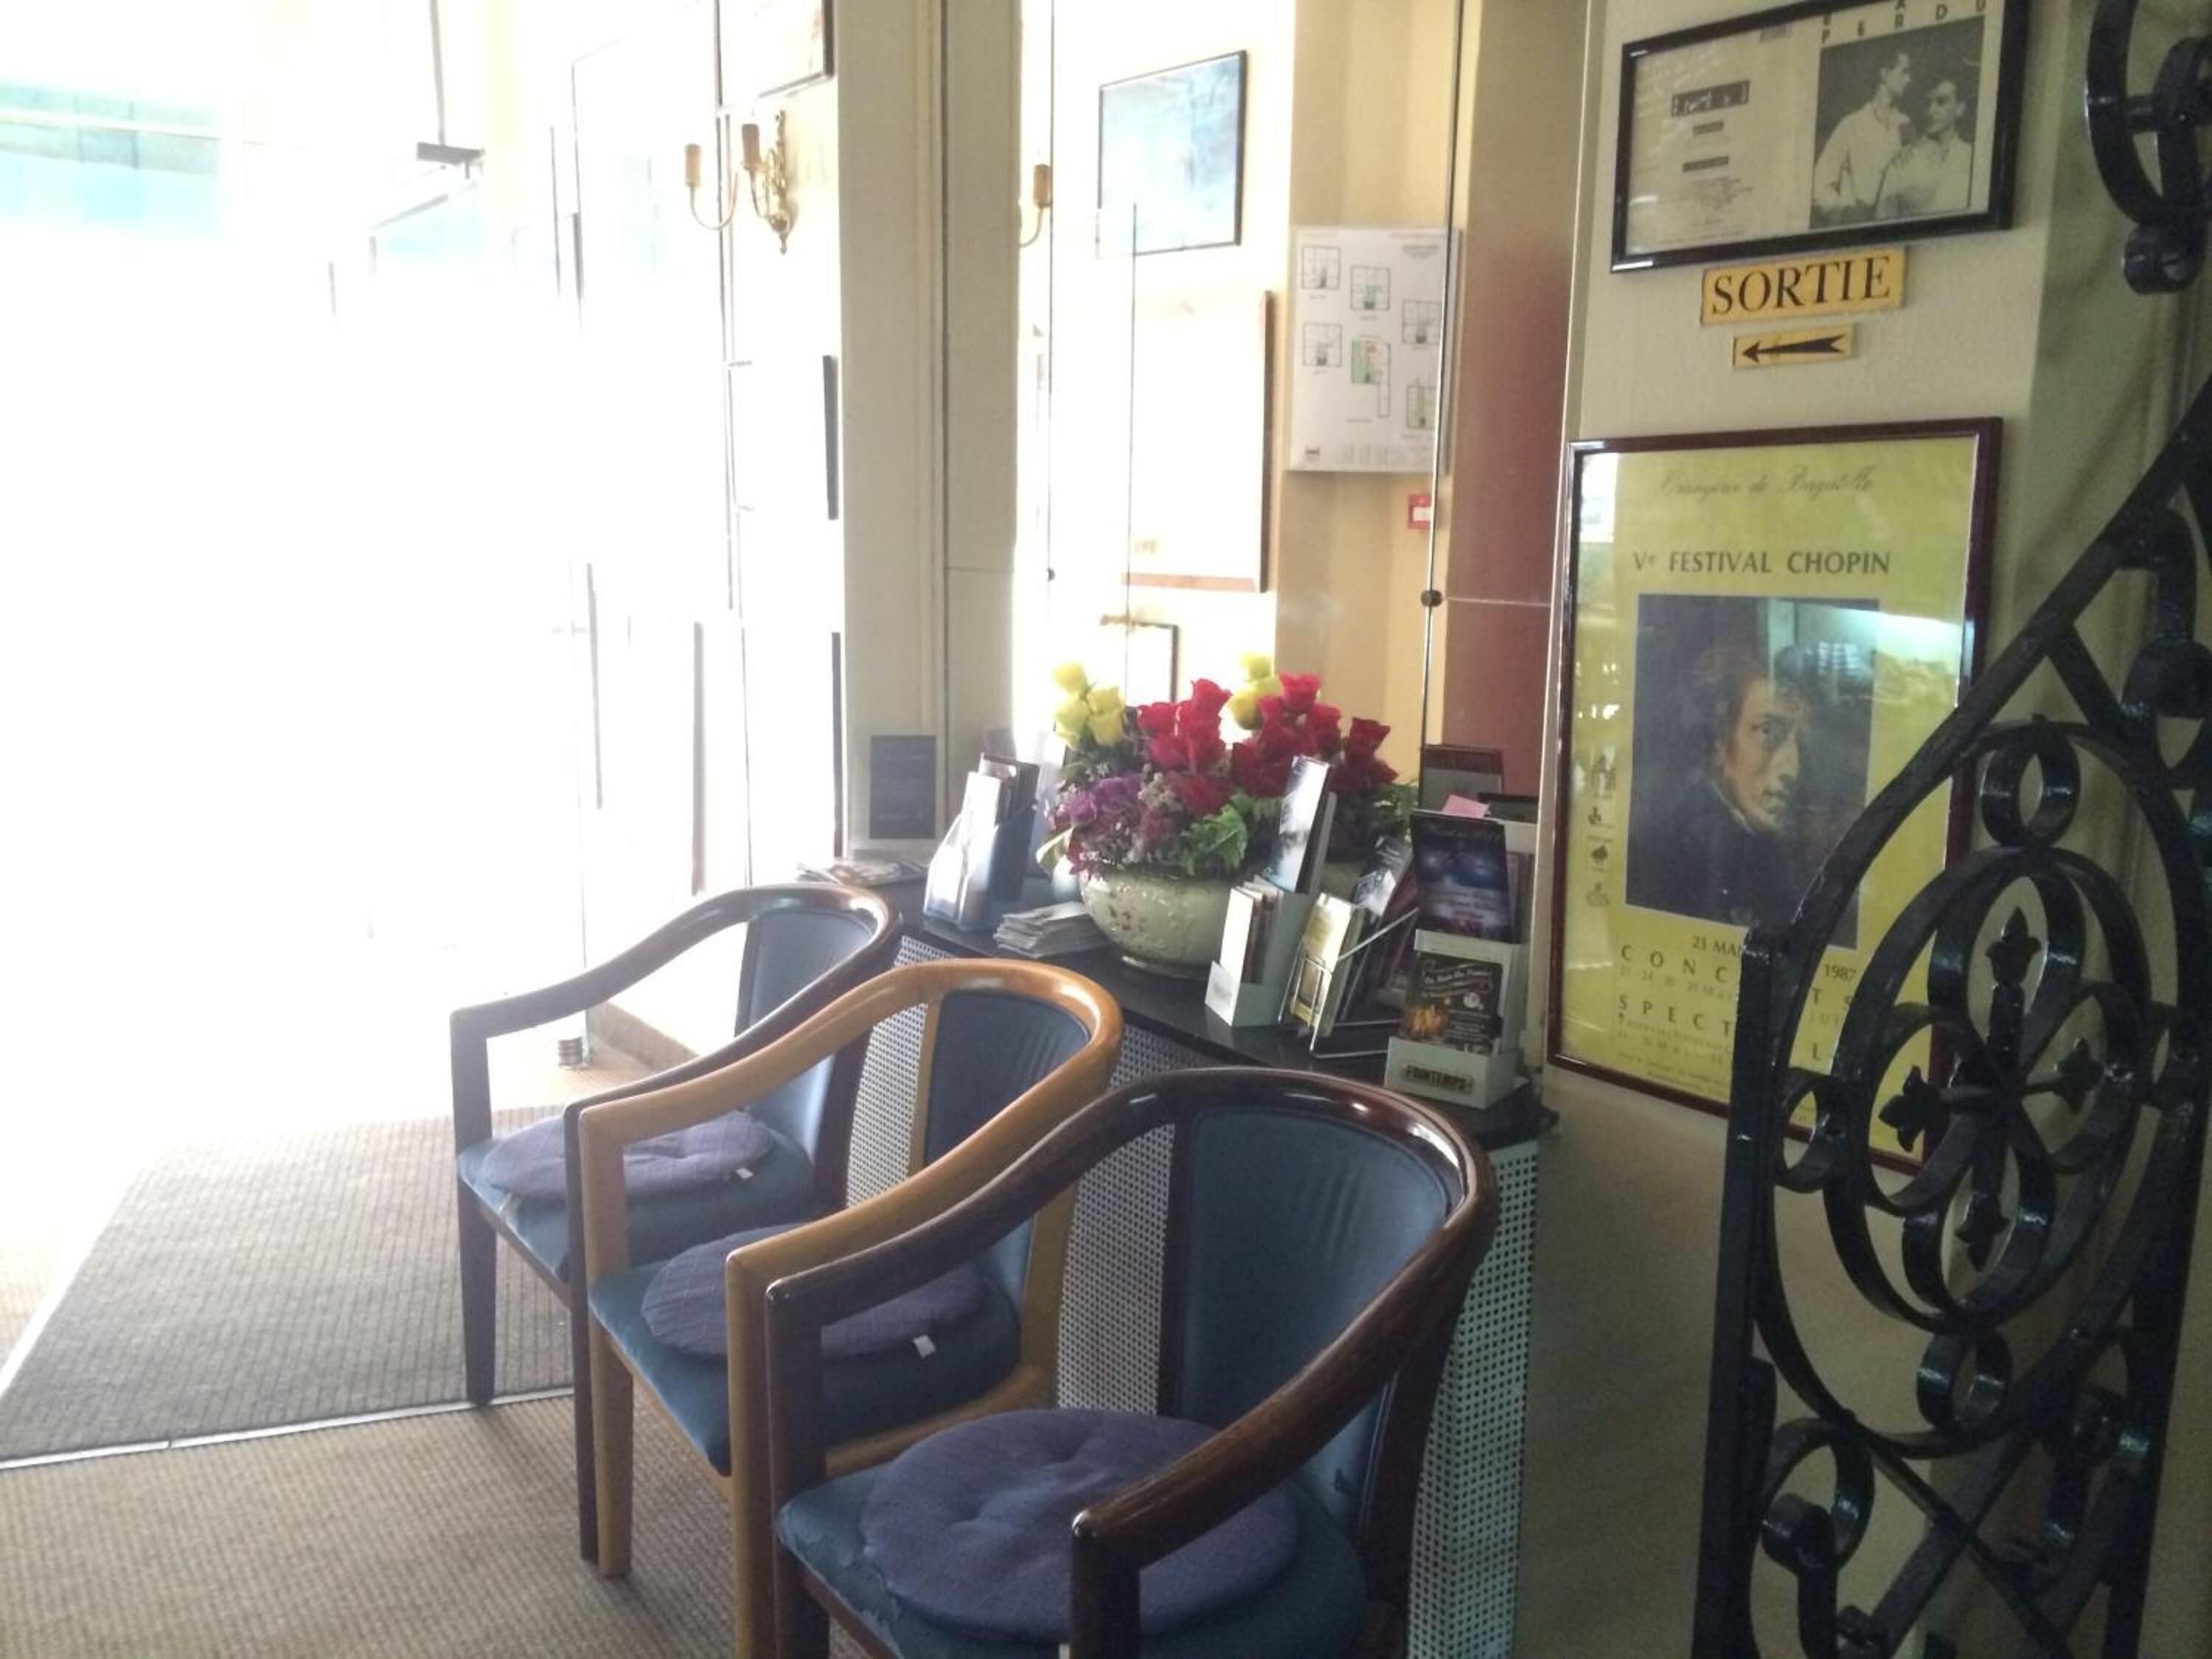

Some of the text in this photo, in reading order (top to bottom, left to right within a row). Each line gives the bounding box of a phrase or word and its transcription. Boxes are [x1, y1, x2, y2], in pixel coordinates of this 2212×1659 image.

[1712, 256, 1890, 315] SORTIE
[1669, 551, 1771, 574] FESTIVAL
[1787, 552, 1891, 574] CHOPIN
[1824, 963, 1857, 981] 1987
